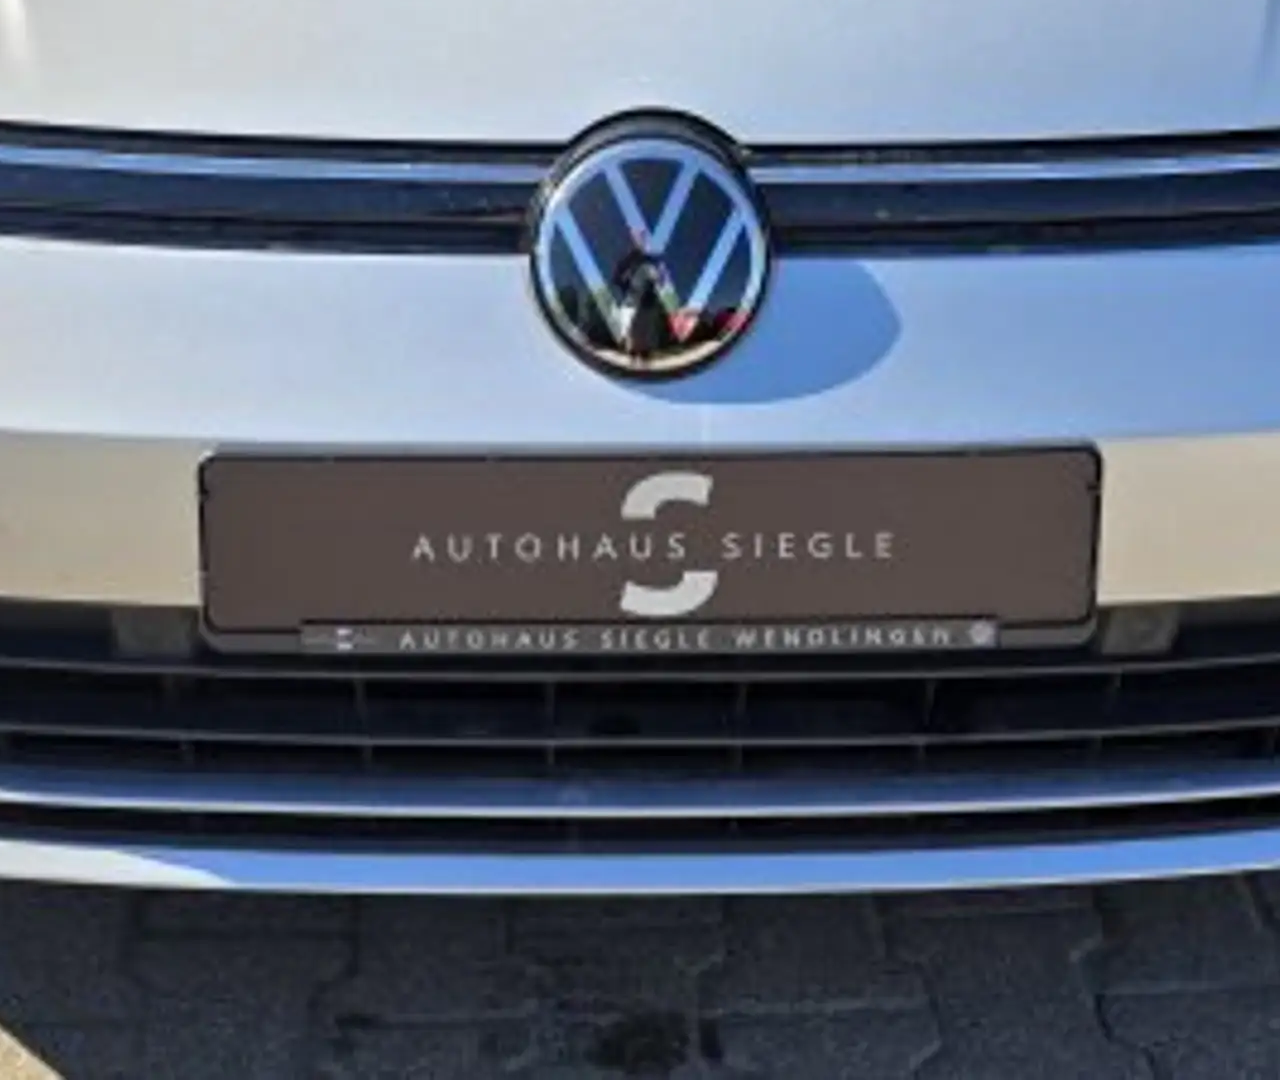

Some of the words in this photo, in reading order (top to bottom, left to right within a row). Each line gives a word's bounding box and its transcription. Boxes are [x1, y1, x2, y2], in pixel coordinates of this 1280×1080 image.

[548, 148, 756, 350] VW
[412, 532, 687, 561] AUTOHAUS
[721, 531, 894, 558] SIEGLE
[399, 628, 578, 651] AUTOHAUS
[600, 627, 711, 650] SIEGLE
[734, 623, 951, 649] WENDLINGEN
